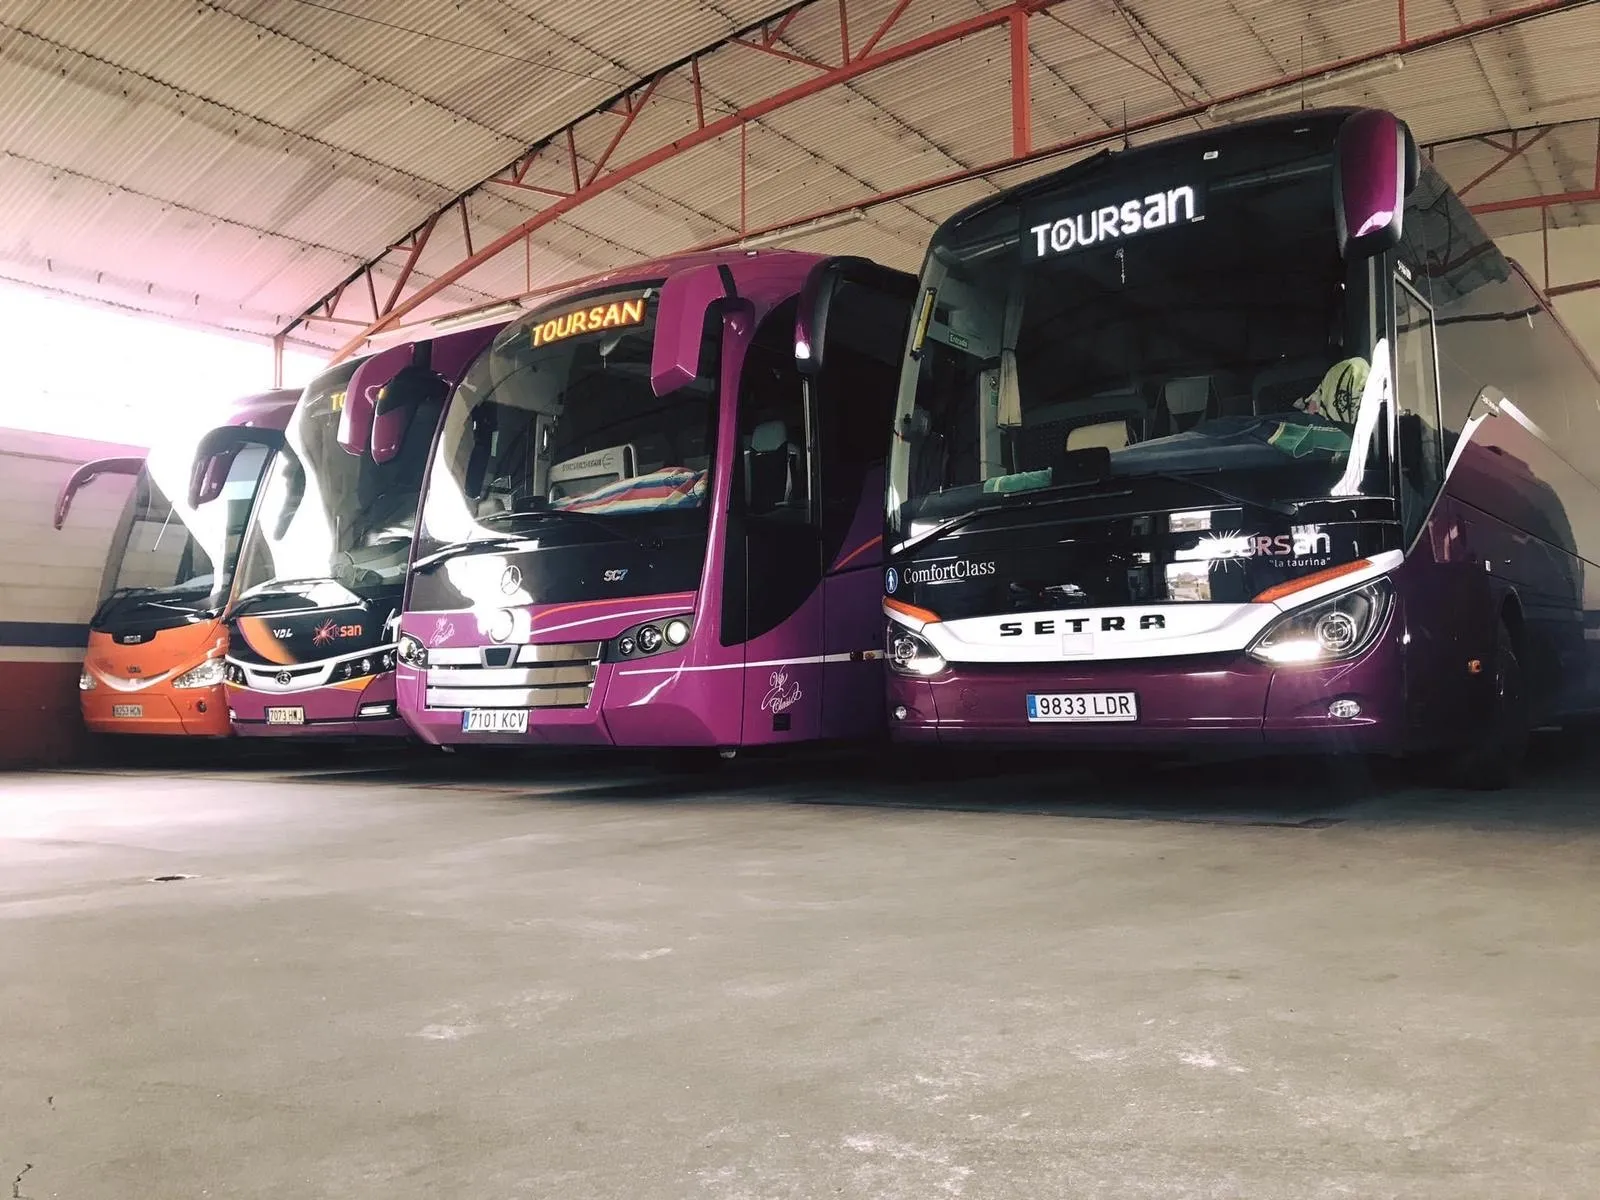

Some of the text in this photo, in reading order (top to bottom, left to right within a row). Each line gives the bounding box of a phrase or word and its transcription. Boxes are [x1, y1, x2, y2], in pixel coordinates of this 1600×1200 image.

[532, 299, 643, 346] TOURSAN
[603, 569, 629, 582] SC7
[903, 560, 996, 585] ComfortClass
[273, 628, 293, 639] VDL
[1000, 614, 1166, 637] SETRA
[1040, 695, 1131, 715] 9833 LDR
[270, 710, 287, 721] 7073
[470, 712, 526, 728] 7101 KCV
